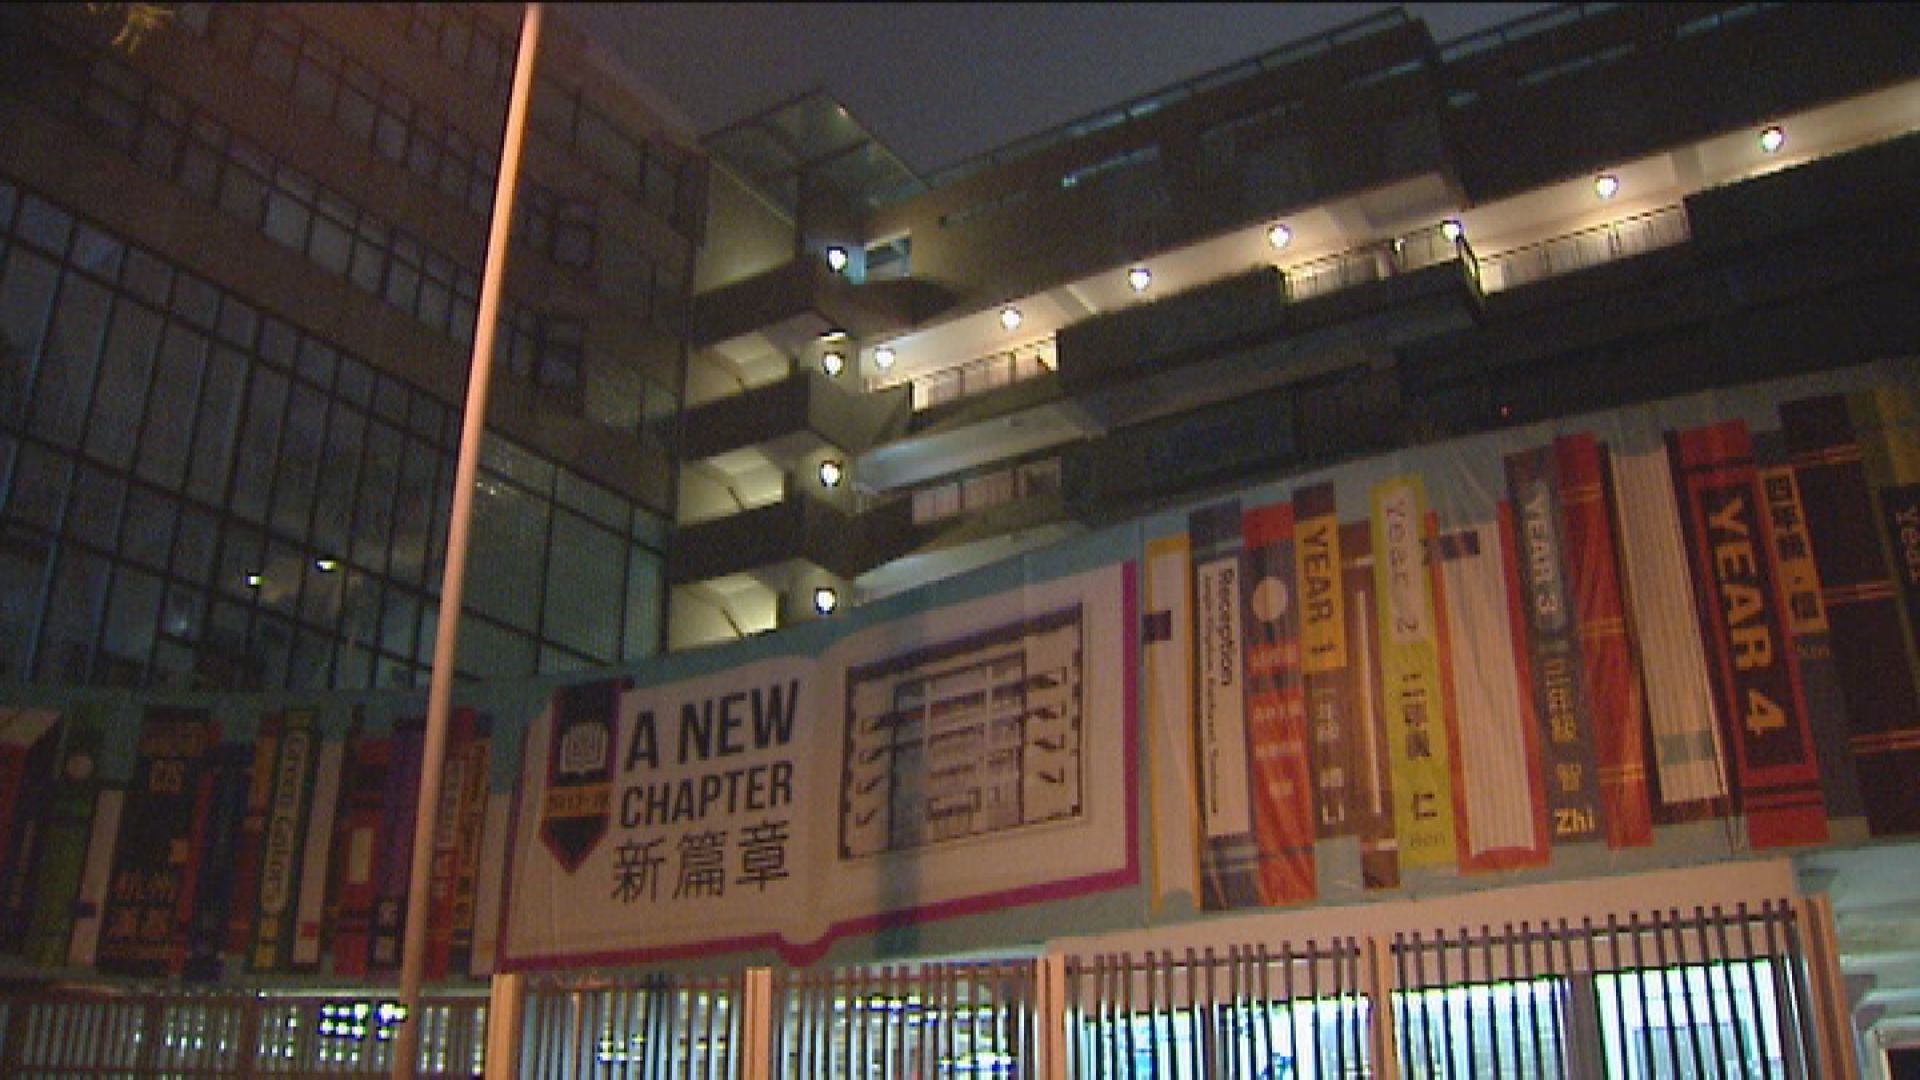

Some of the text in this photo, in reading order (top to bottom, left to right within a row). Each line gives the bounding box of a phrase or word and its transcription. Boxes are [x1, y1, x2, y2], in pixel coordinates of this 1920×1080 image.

[1304, 526, 1336, 654] YEAR 1
[1387, 500, 1418, 634] Year 2
[1522, 492, 1558, 615] YEAR 3
[1218, 568, 1233, 688] Reception
[1708, 492, 1787, 736] YEAR 4
[626, 680, 799, 772] A NEW
[622, 760, 792, 830] CHAPTER
[1553, 805, 1595, 835] Zhi
[613, 821, 790, 903] 新篇章
